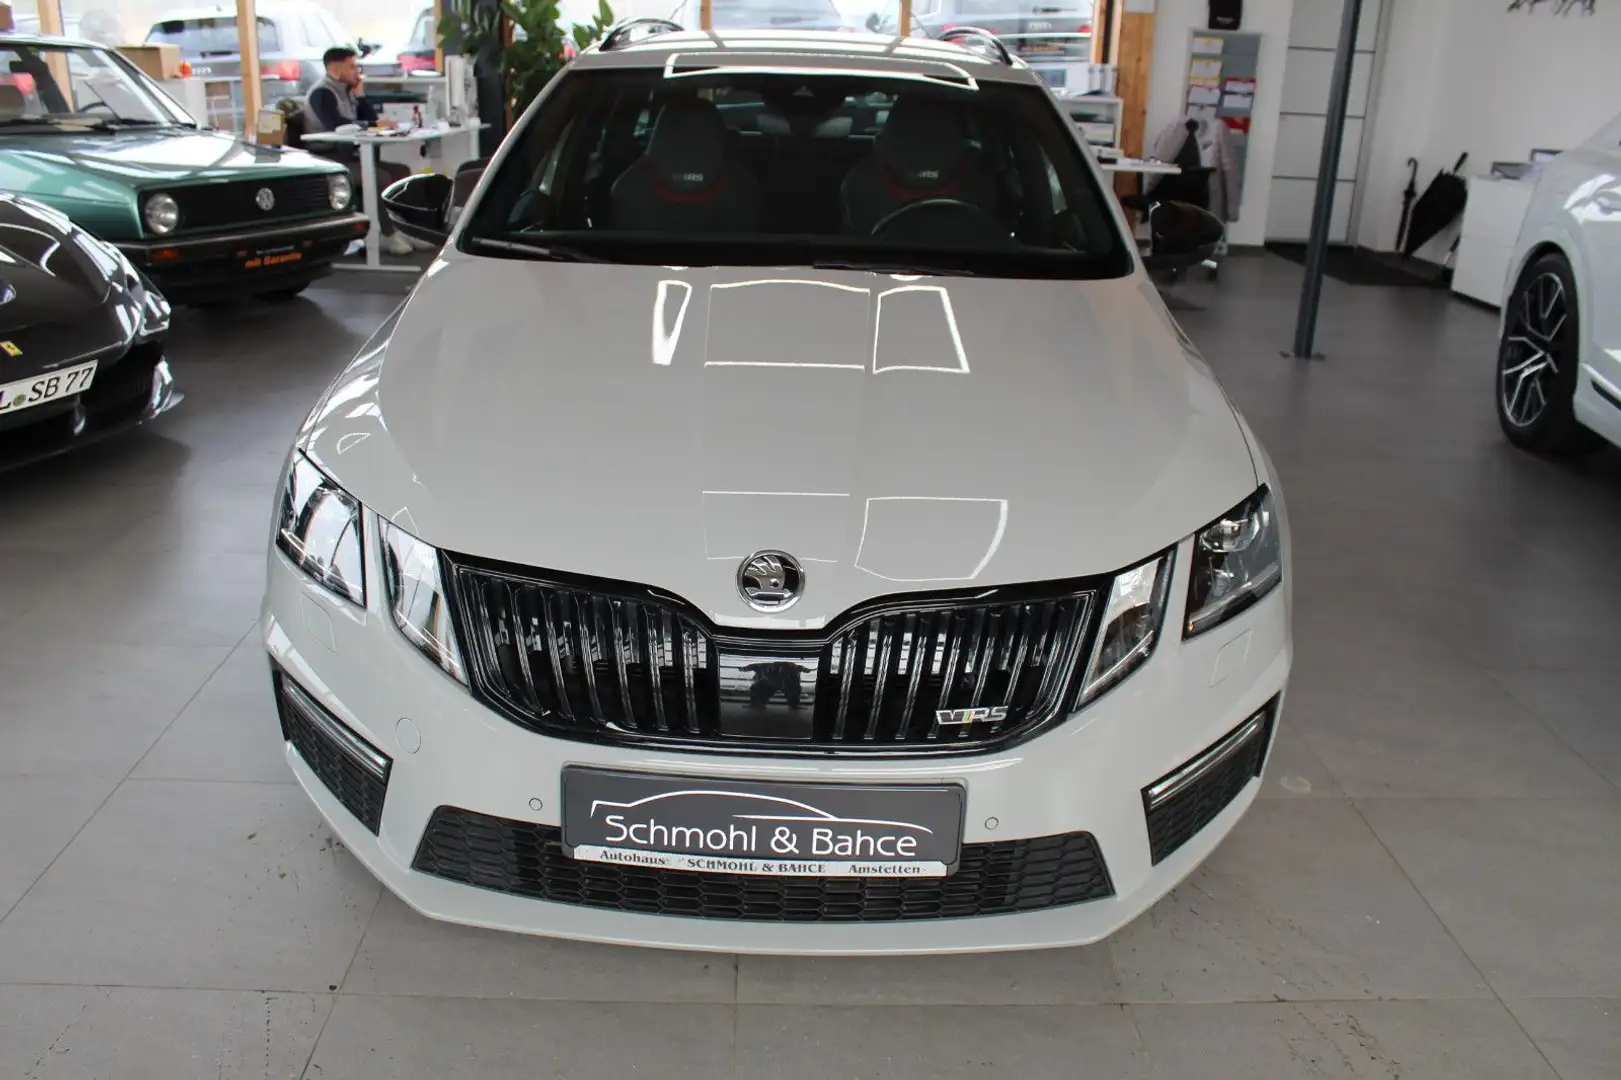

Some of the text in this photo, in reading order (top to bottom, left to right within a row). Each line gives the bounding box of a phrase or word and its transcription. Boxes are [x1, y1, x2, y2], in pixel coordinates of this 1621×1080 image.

[28, 376, 61, 402] SB
[65, 367, 94, 393] 77
[605, 815, 917, 857] Schmohl & Bahce
[600, 849, 921, 875] Autohaus SCHMOHL & BAHCE Amstetten
